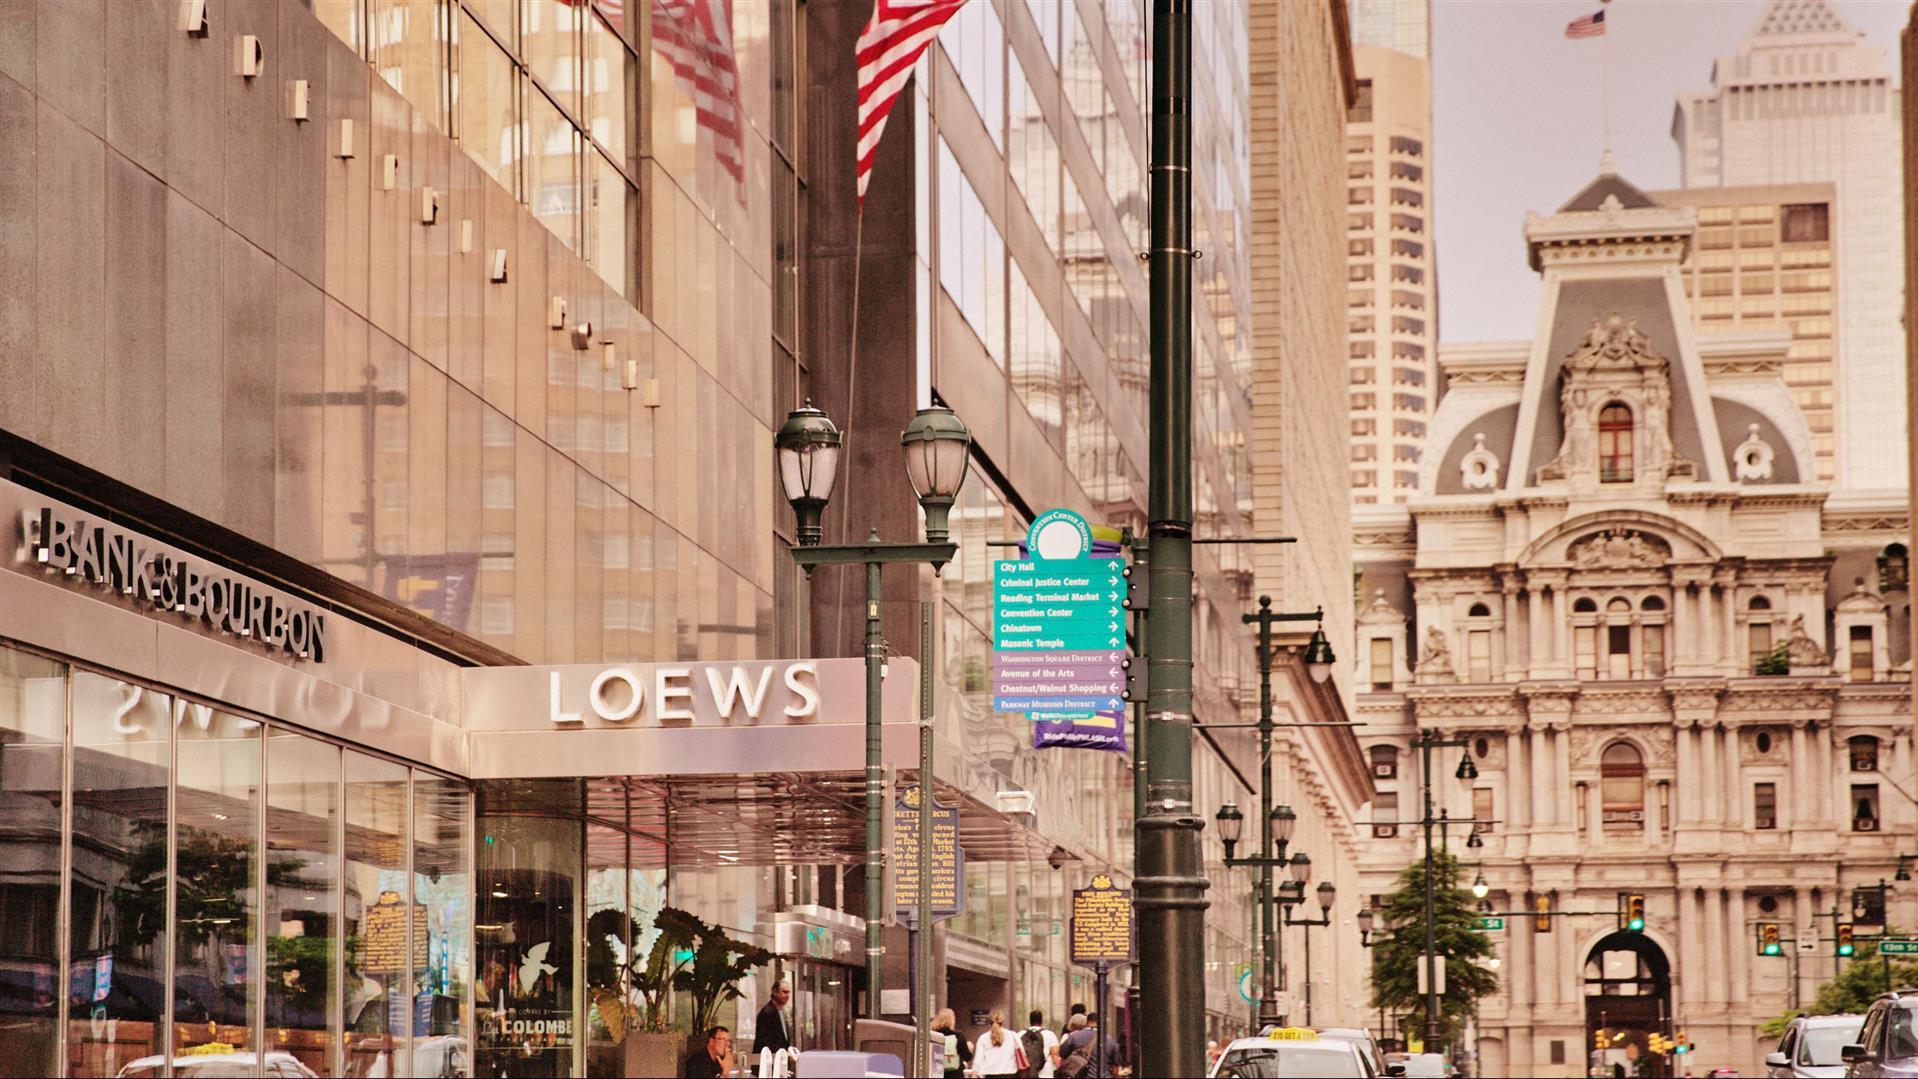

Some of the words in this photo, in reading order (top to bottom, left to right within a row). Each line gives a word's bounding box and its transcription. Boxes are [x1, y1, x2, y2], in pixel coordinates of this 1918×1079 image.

[1028, 514, 1053, 551] CONVENTION
[1052, 511, 1078, 524] CENTER
[1077, 521, 1089, 552] DISTRICT
[1000, 563, 1016, 572] City
[1019, 563, 1034, 571] Hall
[42, 508, 154, 601] BANK
[158, 555, 178, 610] &
[180, 562, 327, 663] BOURBON
[1000, 579, 1033, 587] Criminal
[1035, 578, 1061, 587] Justice
[1000, 594, 1033, 604] Reading
[1035, 593, 1069, 602] Terminal
[1072, 593, 1099, 601] Market
[1000, 609, 1044, 617] Convention
[1000, 624, 1042, 632] Chinatown
[1000, 640, 1033, 648] Masonic
[1036, 639, 1064, 648] Temple
[1045, 654, 1070, 663] SQUARE
[1001, 670, 1030, 678] Avenue
[551, 662, 818, 724] LOEWS
[1001, 684, 1066, 693] Chestnut/Walnut
[1069, 684, 1107, 694] Shopping
[1487, 920, 1499, 928] St
[504, 1020, 572, 1034] COLOMBE
